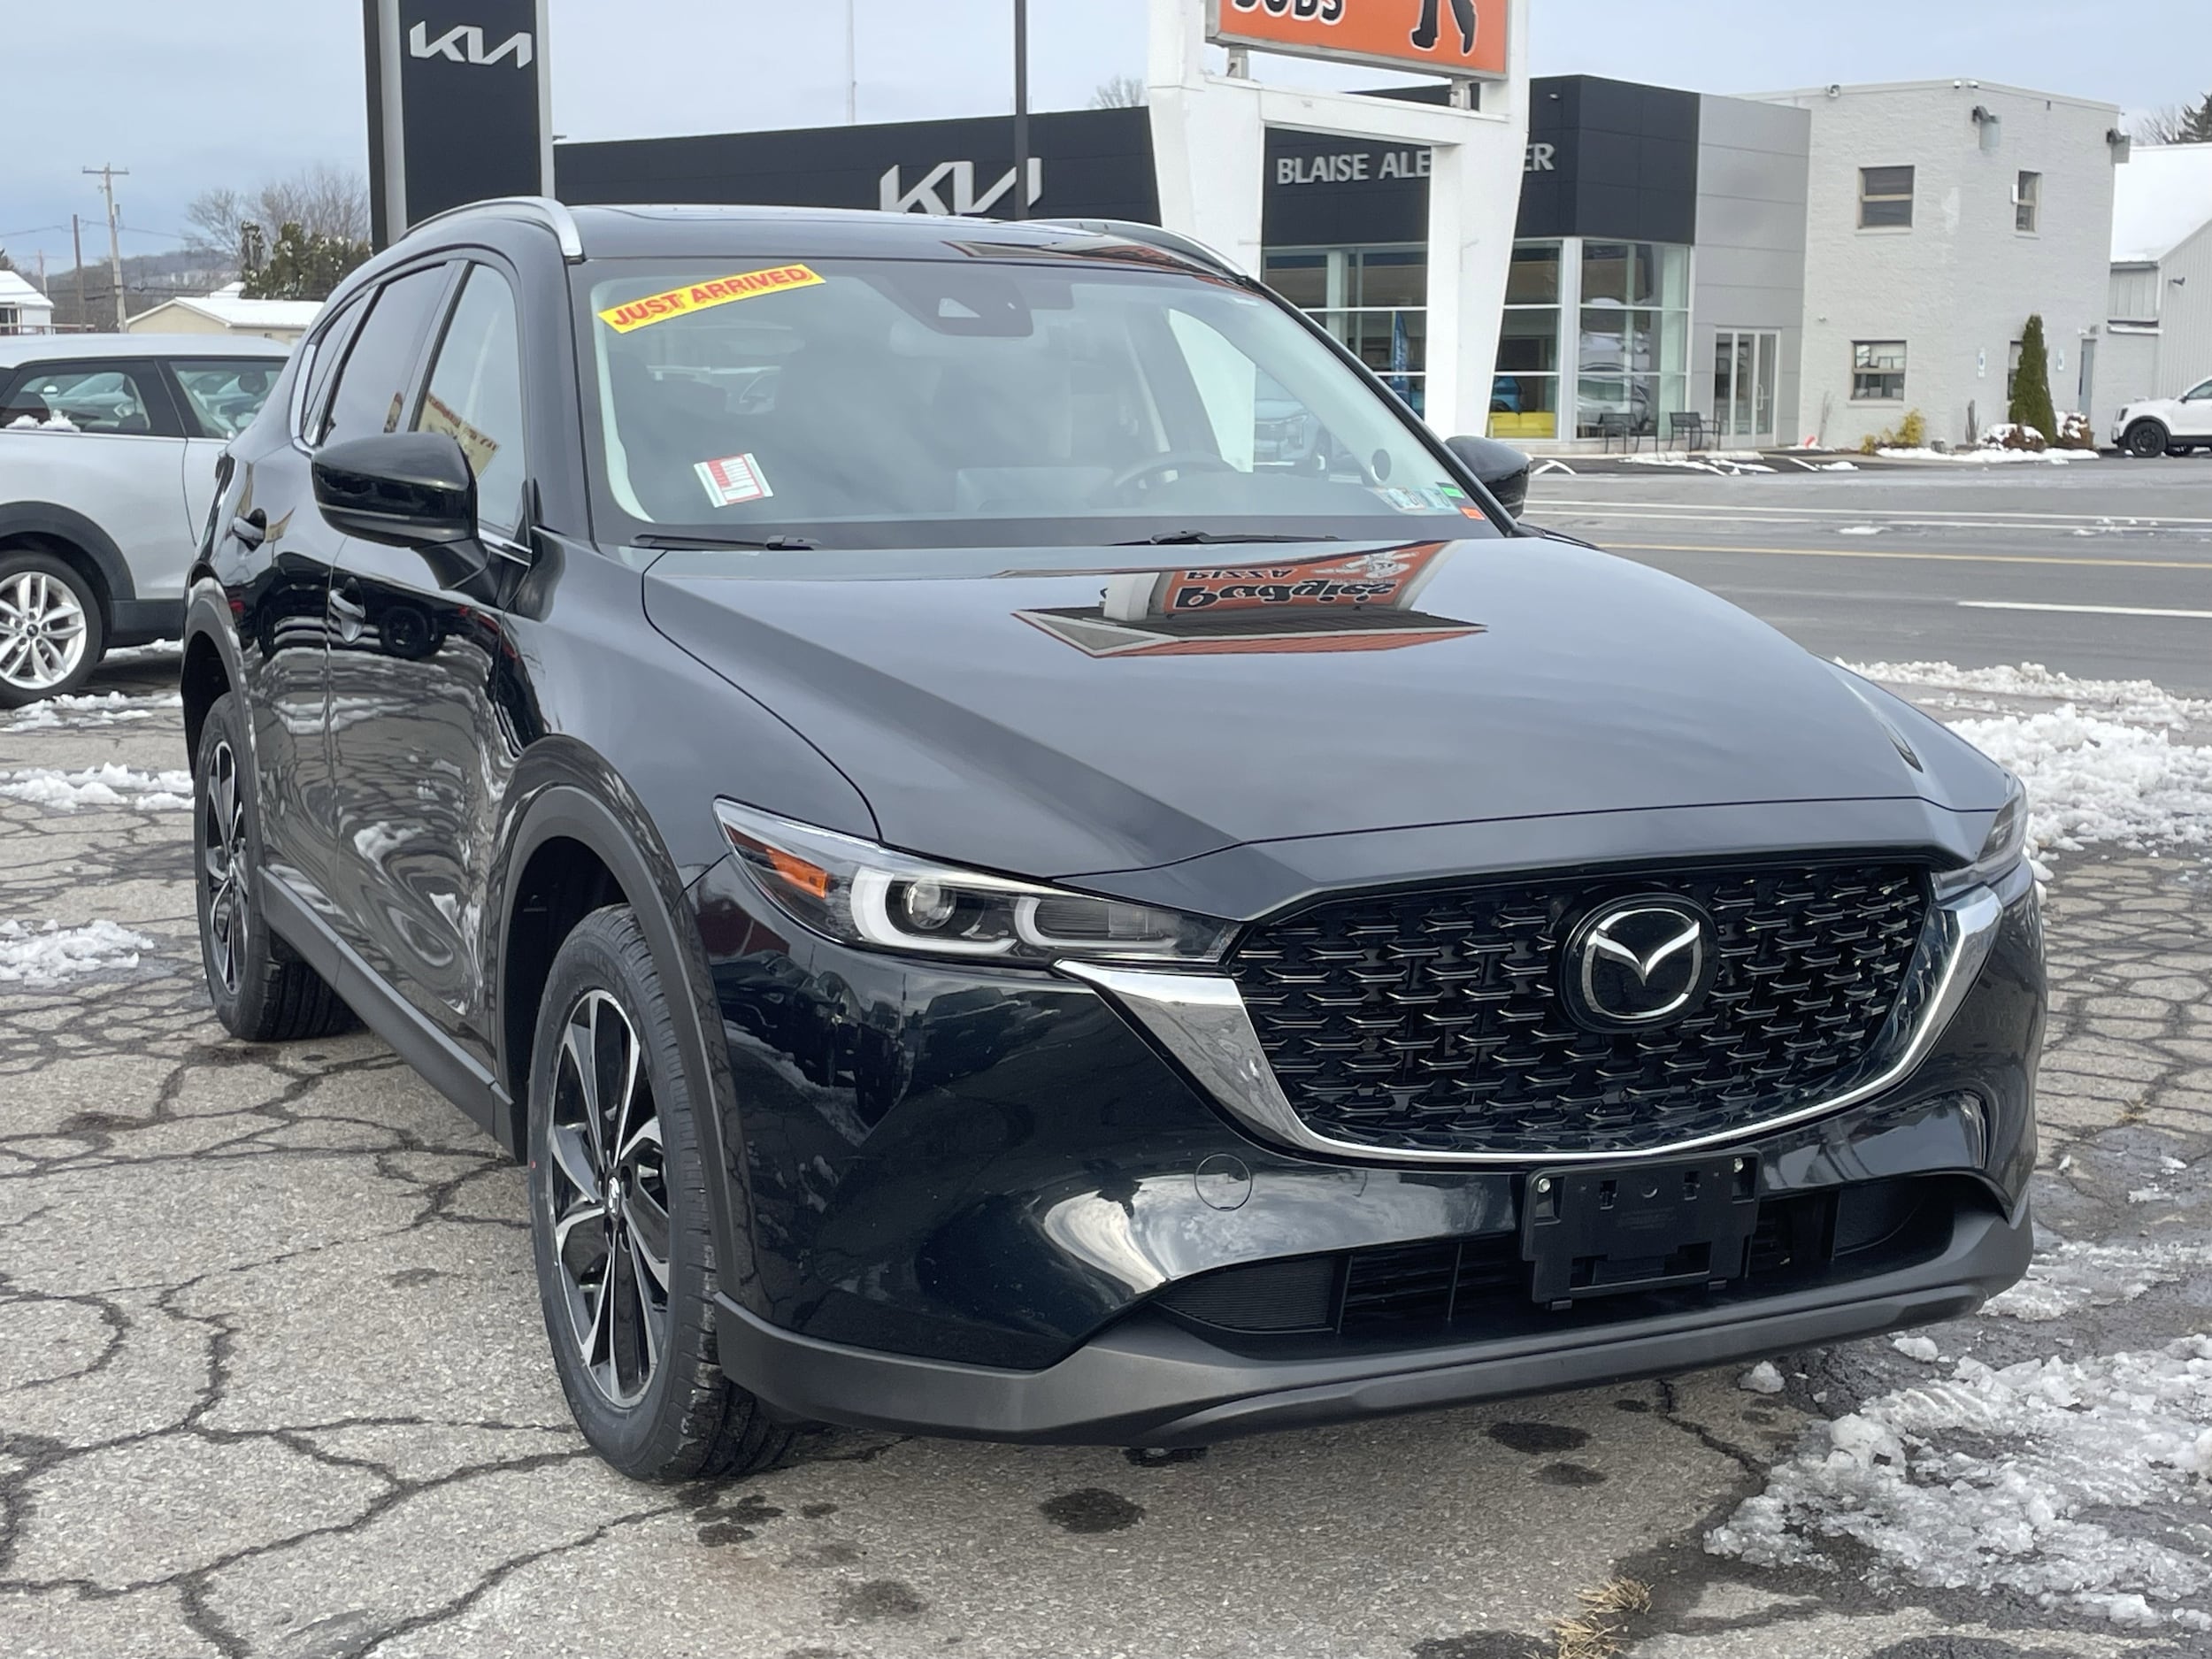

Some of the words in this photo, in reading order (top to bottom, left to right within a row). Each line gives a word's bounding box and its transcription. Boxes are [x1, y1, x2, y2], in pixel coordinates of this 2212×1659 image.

[410, 20, 533, 69] KIA
[1276, 153, 1370, 185] BLAISE
[614, 294, 684, 326] JUST
[690, 268, 813, 303] ARRIVED
